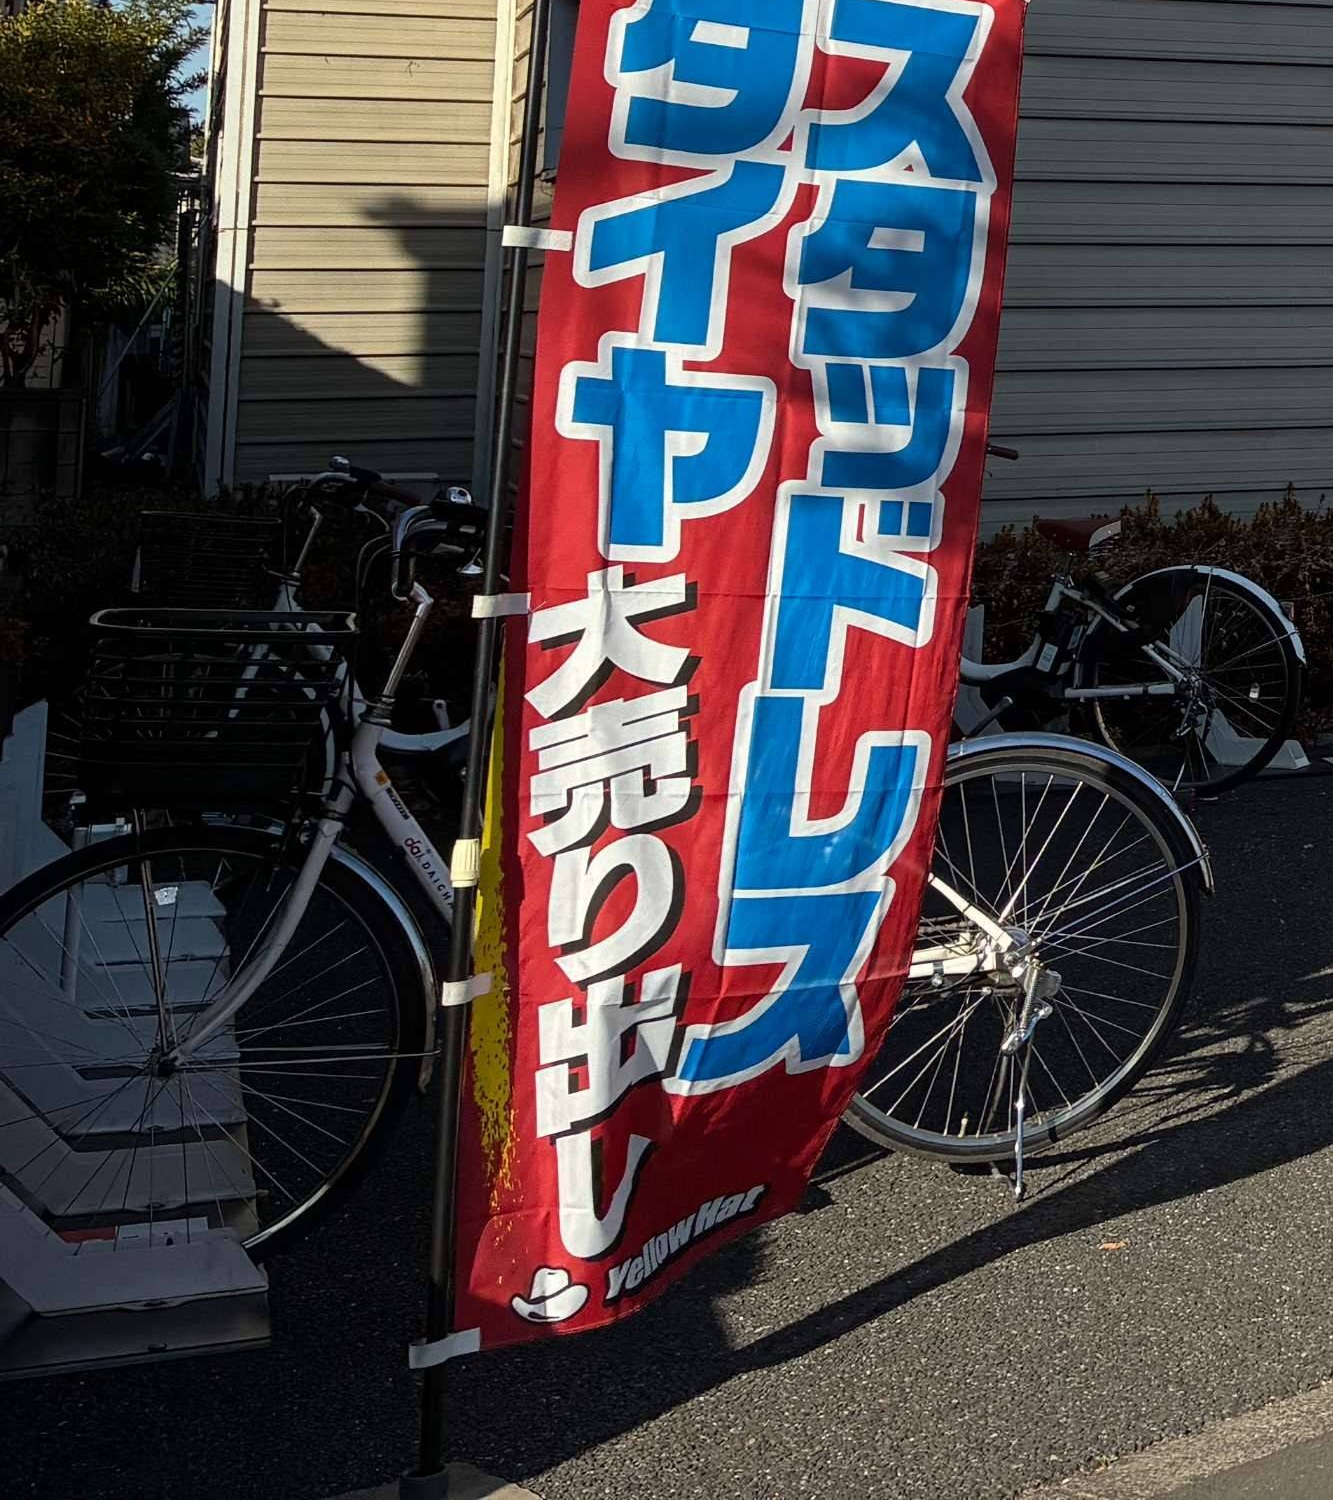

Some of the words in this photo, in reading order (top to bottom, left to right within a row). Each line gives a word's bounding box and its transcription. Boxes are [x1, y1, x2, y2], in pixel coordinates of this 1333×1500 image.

[526, 562, 698, 1260] 大売り出し
[604, 1183, 768, 1302] YellowHat
